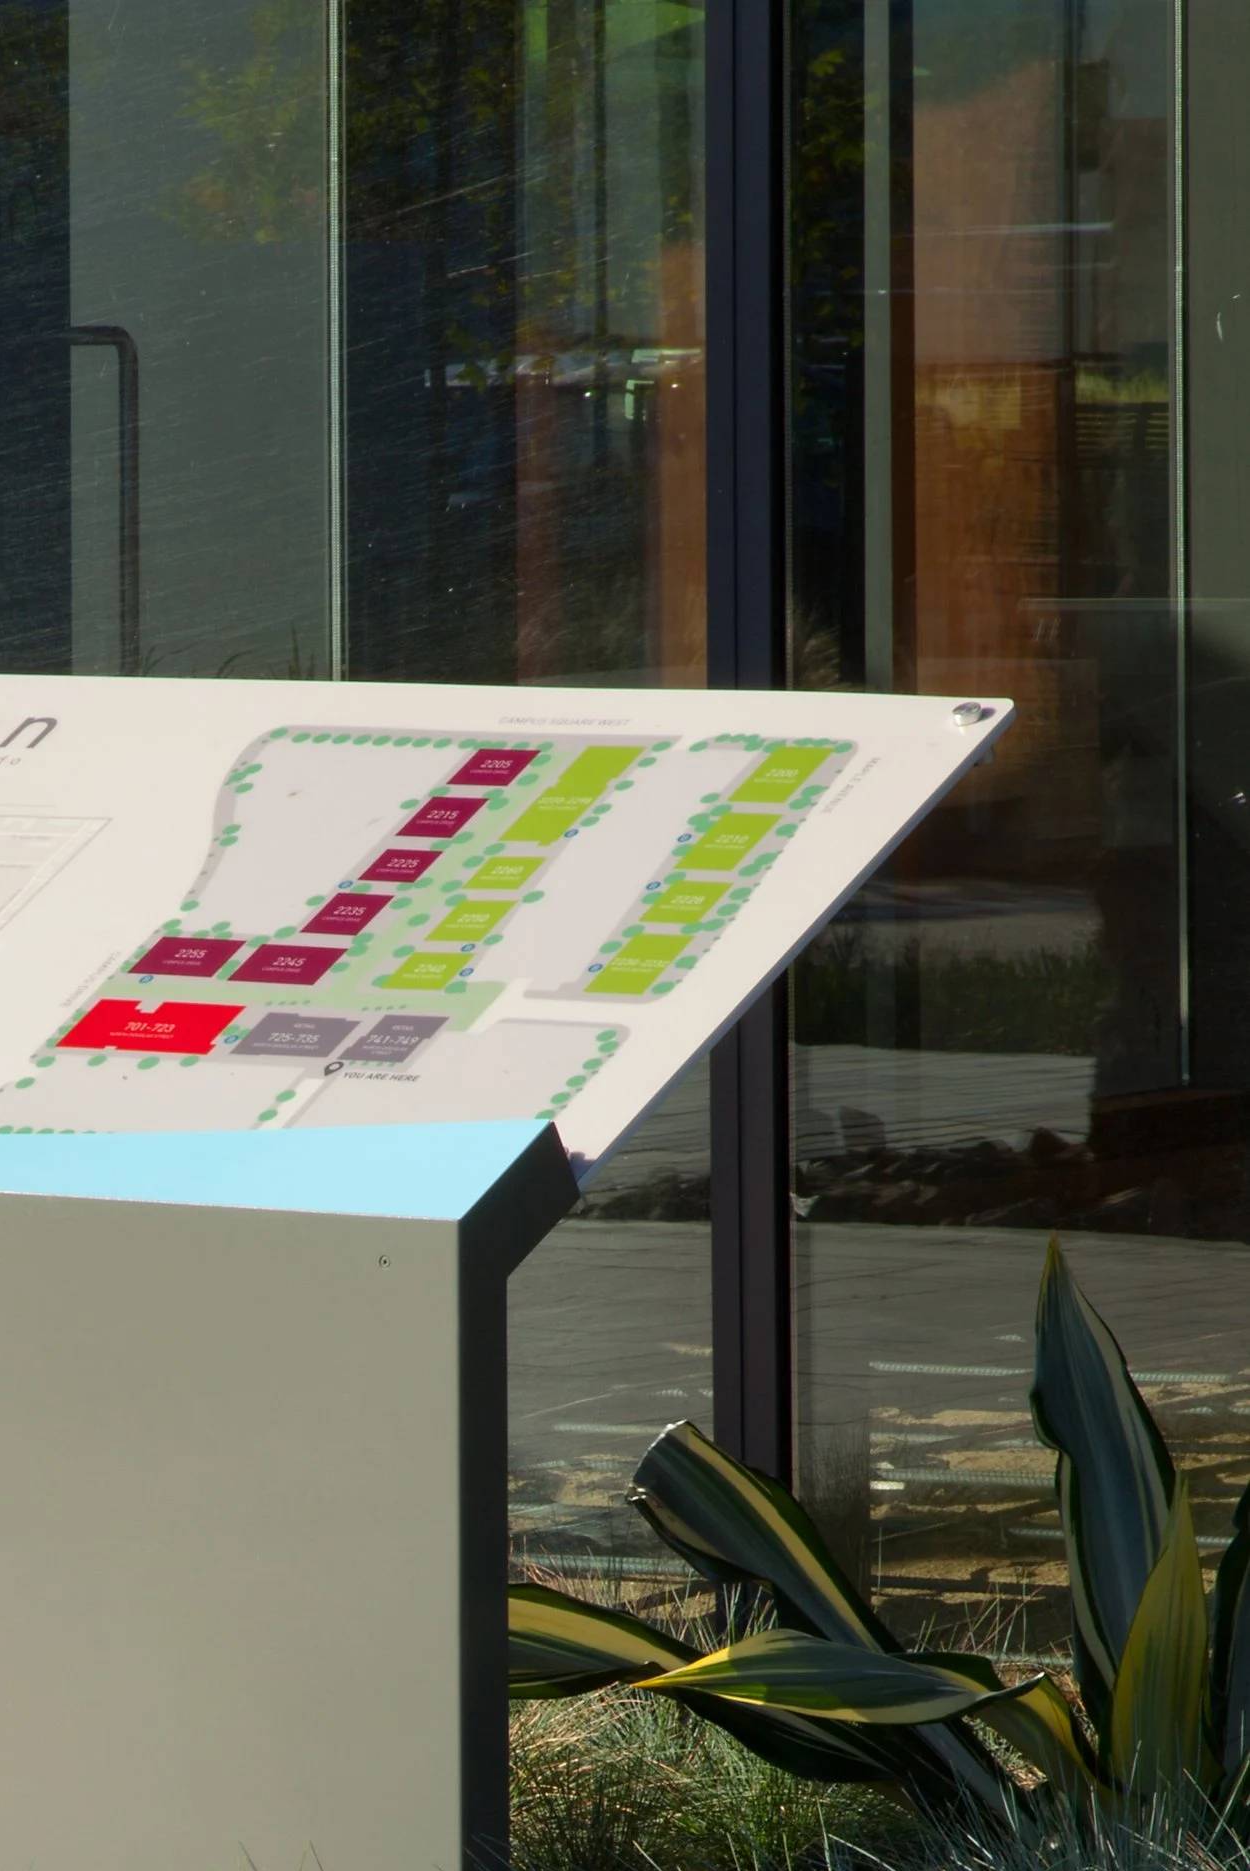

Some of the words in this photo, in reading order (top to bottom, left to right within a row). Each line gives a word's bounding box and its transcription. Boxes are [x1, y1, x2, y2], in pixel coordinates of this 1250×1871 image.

[498, 716, 547, 725] CAMPUS
[549, 717, 596, 726] SQUARE
[597, 718, 633, 726] WEST
[480, 759, 514, 769] 2205
[426, 810, 459, 819] 2215
[386, 858, 421, 868] 2225
[333, 906, 367, 916] 2235
[174, 949, 208, 959] 2255
[272, 957, 307, 967] 2245
[413, 963, 447, 973] 2240
[123, 1021, 176, 1032] 701-723
[267, 1031, 321, 1044] 725-735
[365, 1034, 419, 1045] 741-749
[342, 1071, 365, 1080] YOU
[366, 1072, 388, 1081] ARE
[389, 1073, 422, 1083] HERE
